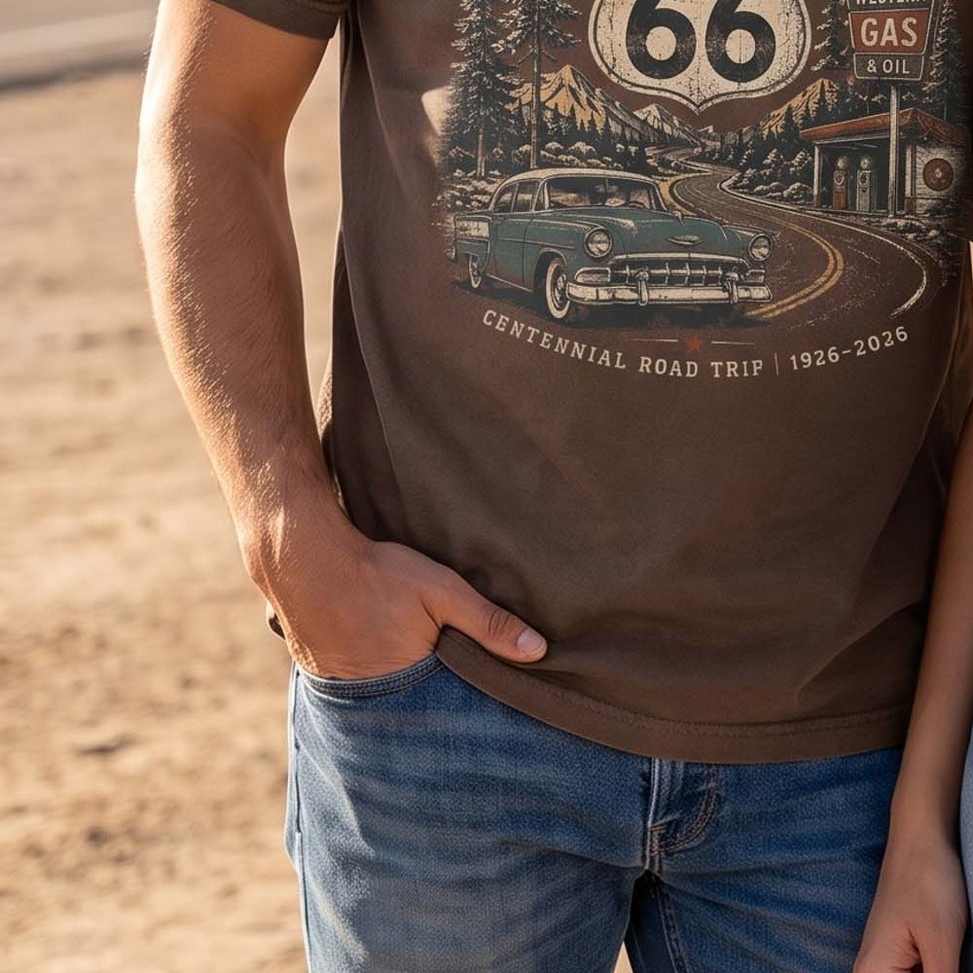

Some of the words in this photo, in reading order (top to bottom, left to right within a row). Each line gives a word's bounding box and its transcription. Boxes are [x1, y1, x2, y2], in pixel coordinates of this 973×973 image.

[861, 17, 918, 46] GAS
[867, 58, 877, 73] &
[882, 58, 910, 74] OIL
[482, 309, 626, 369] CENTENNIAL
[638, 356, 698, 378] ROAD
[710, 359, 763, 378] TRIP
[789, 326, 908, 371] 1926-2026
